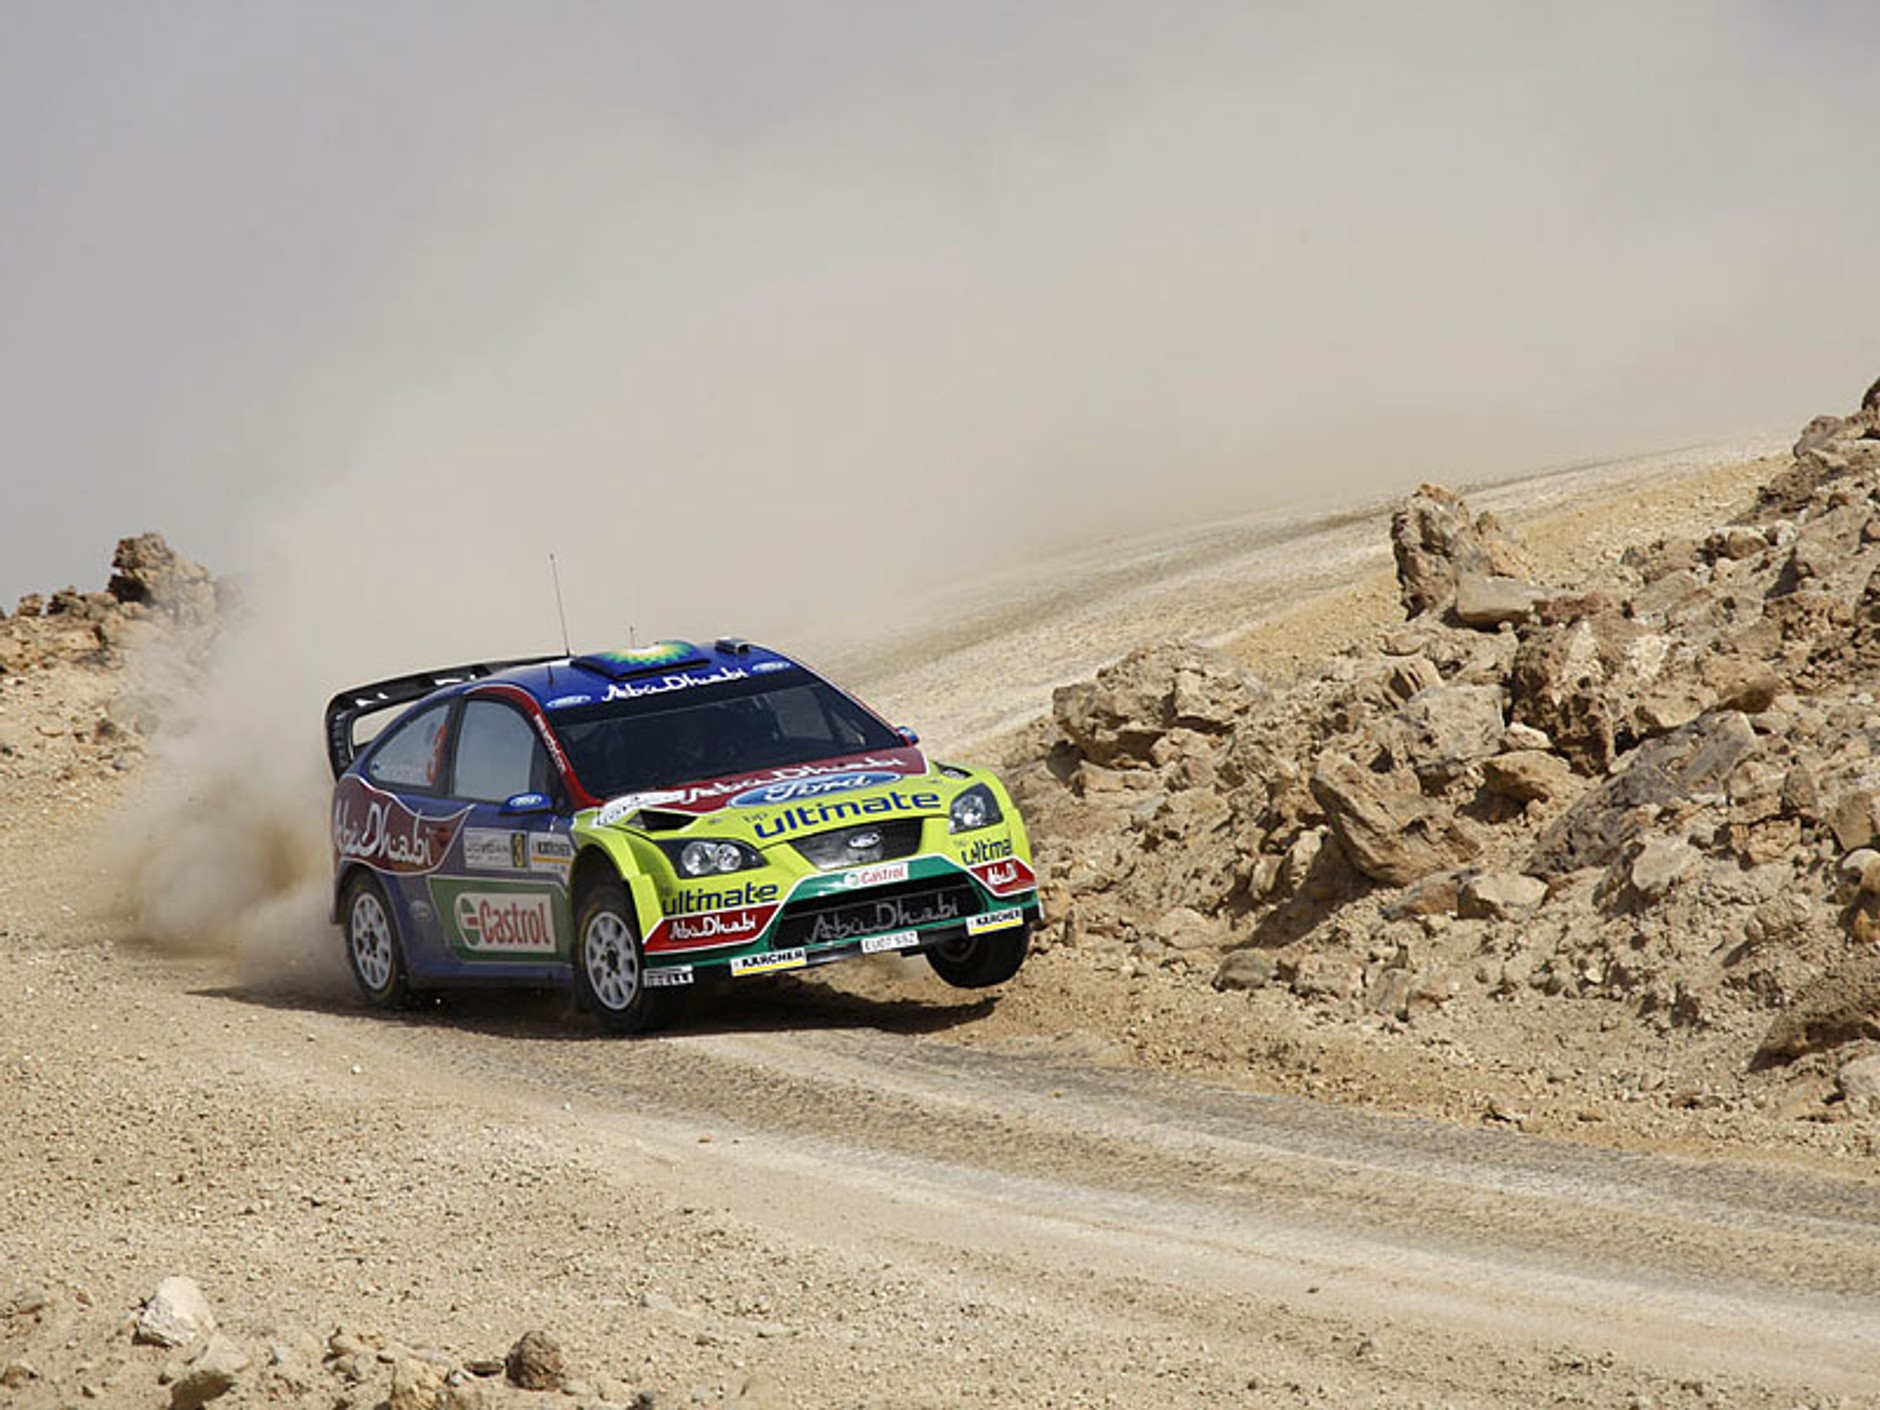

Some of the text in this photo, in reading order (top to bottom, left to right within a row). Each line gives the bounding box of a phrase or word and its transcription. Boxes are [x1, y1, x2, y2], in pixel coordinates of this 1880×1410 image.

[765, 775, 874, 801] Ford
[754, 791, 942, 838] ultimate
[860, 866, 905, 885] Castrol
[662, 881, 779, 915] ultimate
[479, 900, 549, 944] Castrol
